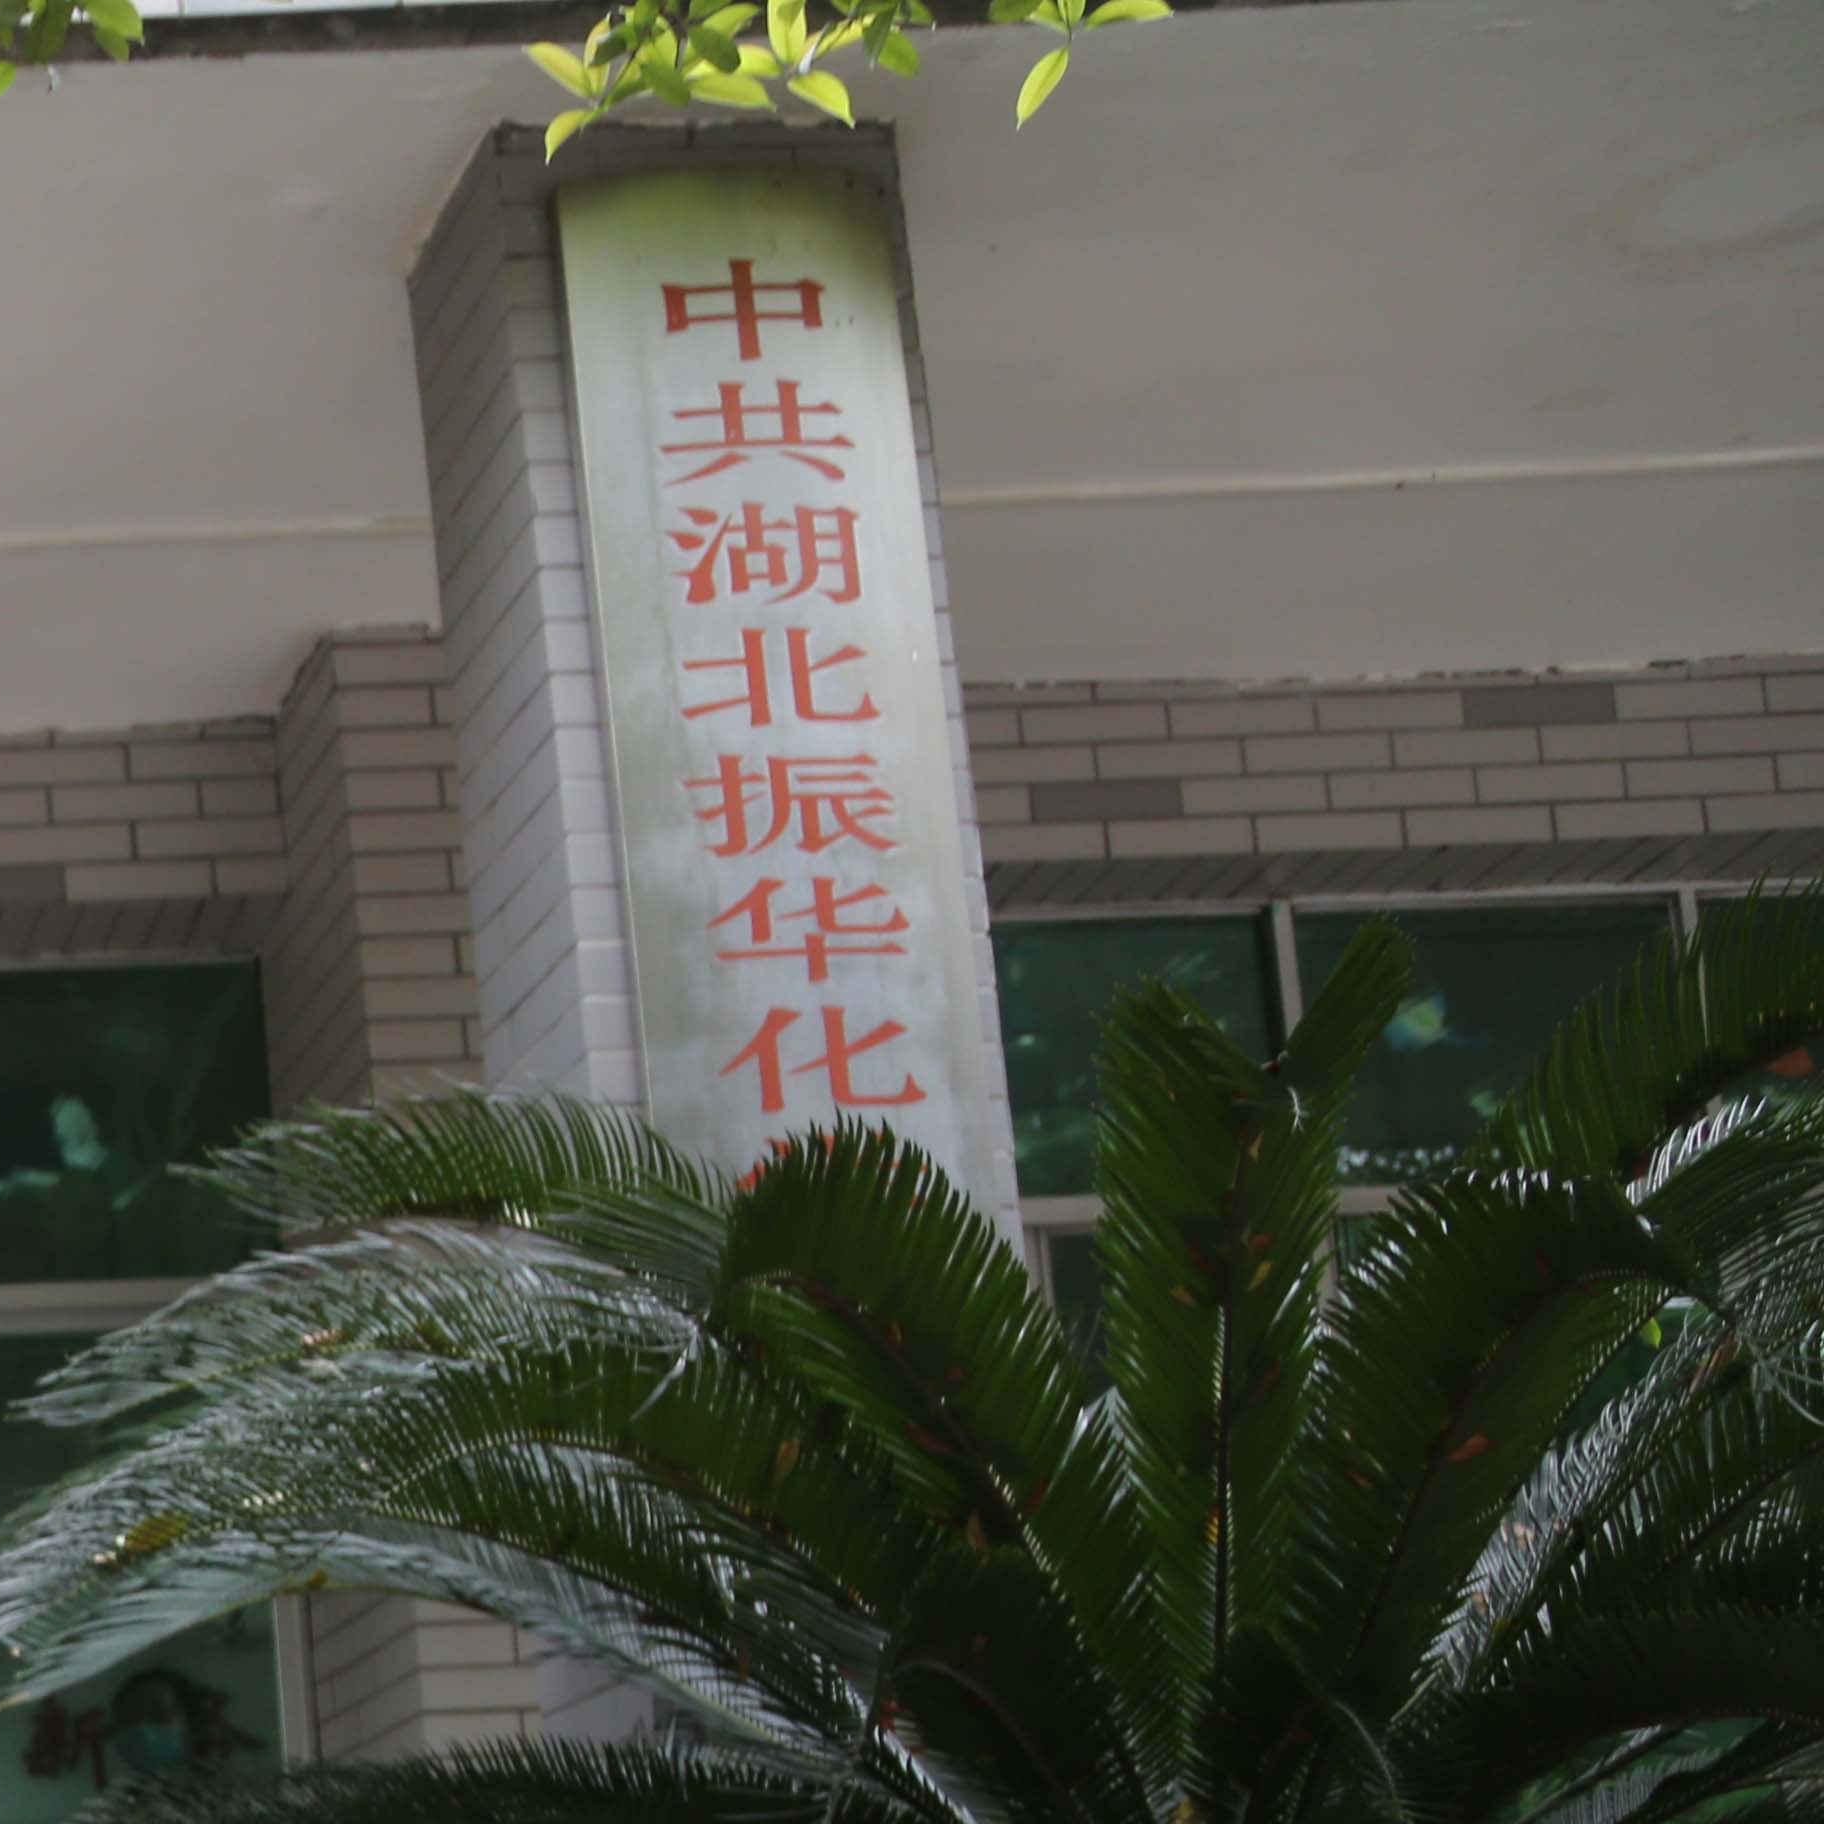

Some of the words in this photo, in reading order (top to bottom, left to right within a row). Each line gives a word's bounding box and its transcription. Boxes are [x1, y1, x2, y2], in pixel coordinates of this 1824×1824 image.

[659, 258, 928, 1192] 中共湖北振华化
